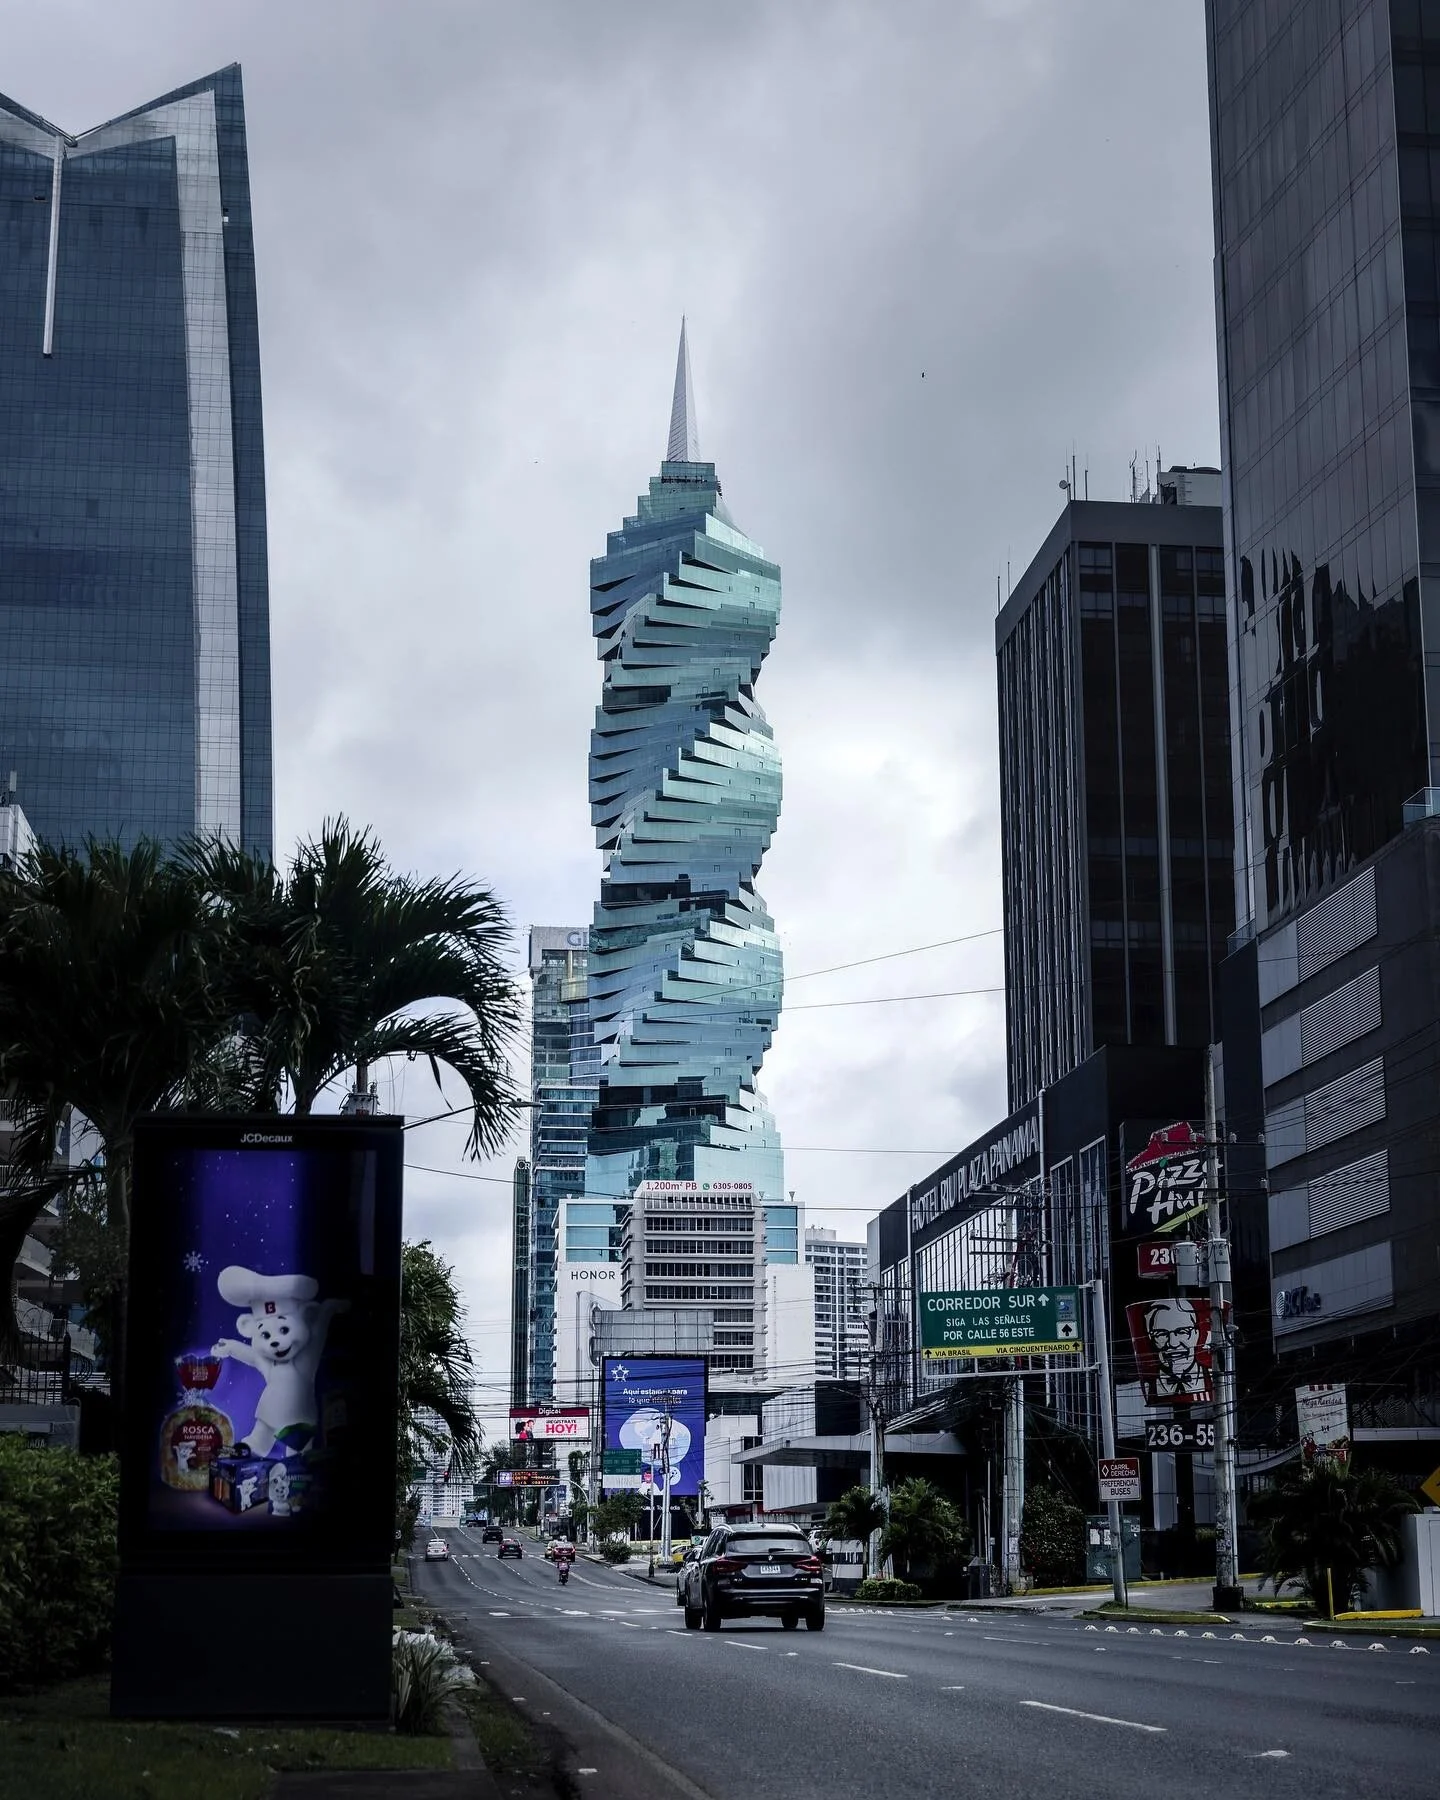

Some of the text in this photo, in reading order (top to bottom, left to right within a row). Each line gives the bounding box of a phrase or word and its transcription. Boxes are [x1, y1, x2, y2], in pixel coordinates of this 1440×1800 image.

[240, 1132, 293, 1144] JCDecaux
[685, 1183, 697, 1191] PB
[911, 1185, 940, 1234] HOTEL
[940, 1171, 958, 1214] RIU
[957, 1150, 991, 1203] PLAZA
[571, 1270, 616, 1280] HONOR
[927, 1294, 1036, 1312] CORREDOR SUR
[946, 1314, 1031, 1327] SIGA LAS SEÑALES
[943, 1327, 1035, 1341] POR CALLE 56 ESTE
[948, 1349, 972, 1357] BRASIL
[995, 1346, 1008, 1355] VIA
[1009, 1344, 1070, 1354] CINCUENTENARIO
[182, 1426, 215, 1435] ROSCA
[545, 1424, 577, 1434] HOY!
[1110, 1469, 1136, 1477] DERECHO
[1110, 1487, 1132, 1496] BUSES
